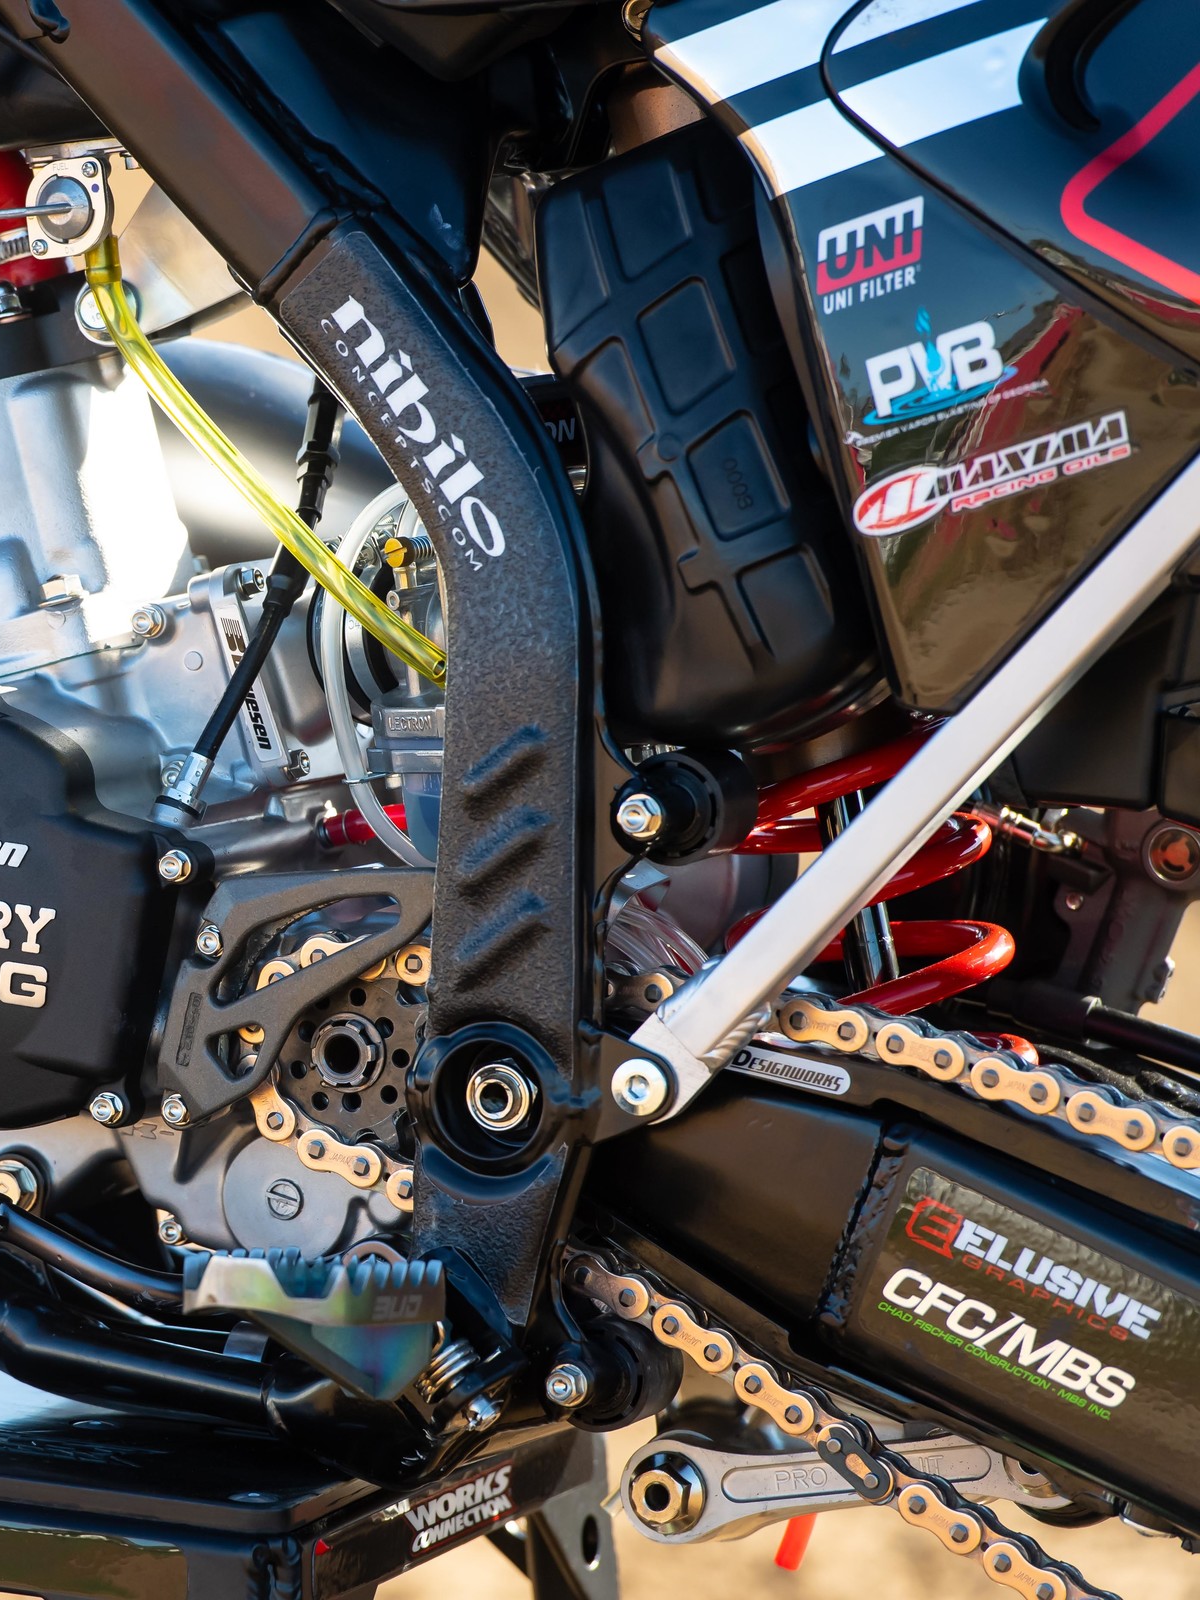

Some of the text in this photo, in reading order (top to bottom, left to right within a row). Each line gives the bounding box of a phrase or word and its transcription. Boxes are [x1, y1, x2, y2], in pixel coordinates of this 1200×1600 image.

[823, 267, 917, 315] UNI FILTER
[865, 321, 1004, 418] PVB
[952, 442, 1132, 512] RACING OILS
[388, 714, 433, 731] LECTRON
[954, 1219, 1161, 1340] ELUSIVE
[962, 1254, 1129, 1341] GRAPHICS
[877, 1301, 913, 1322] CHAD
[913, 1318, 964, 1348] FISCHER
[1057, 1388, 1088, 1409] MBS
[882, 1268, 1136, 1408] CFC/MBS
[404, 1465, 513, 1532] WORKS
[774, 1466, 828, 1491] PRO
[411, 1494, 513, 1553] CONNECTION
